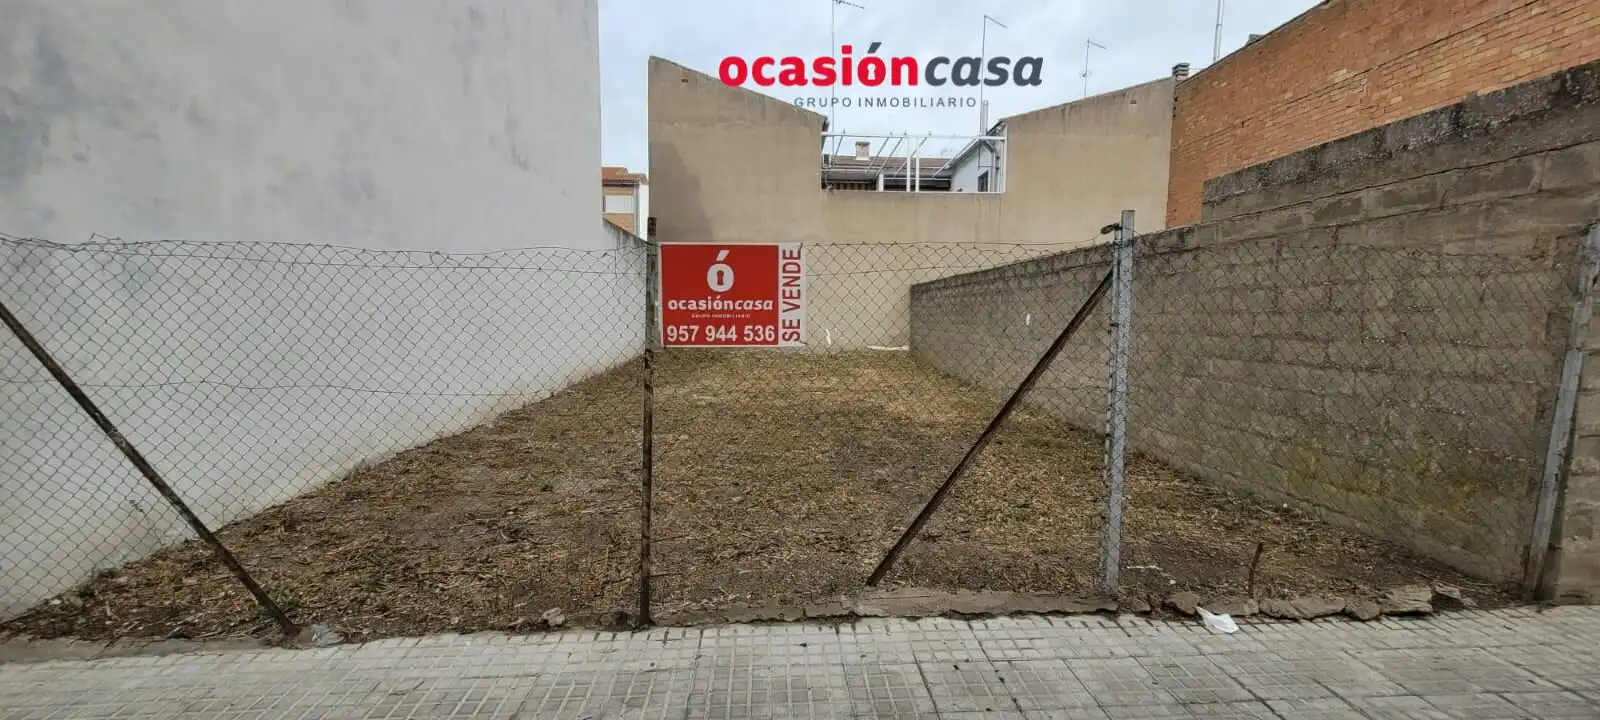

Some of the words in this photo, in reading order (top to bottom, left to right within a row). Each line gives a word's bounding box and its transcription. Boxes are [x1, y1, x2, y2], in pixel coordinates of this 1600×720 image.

[782, 249, 800, 313] VENDE
[667, 295, 773, 311] ocasióncasa
[666, 325, 699, 342] 957
[705, 325, 738, 342] 944
[743, 325, 775, 342] 536
[782, 319, 800, 342] SE
